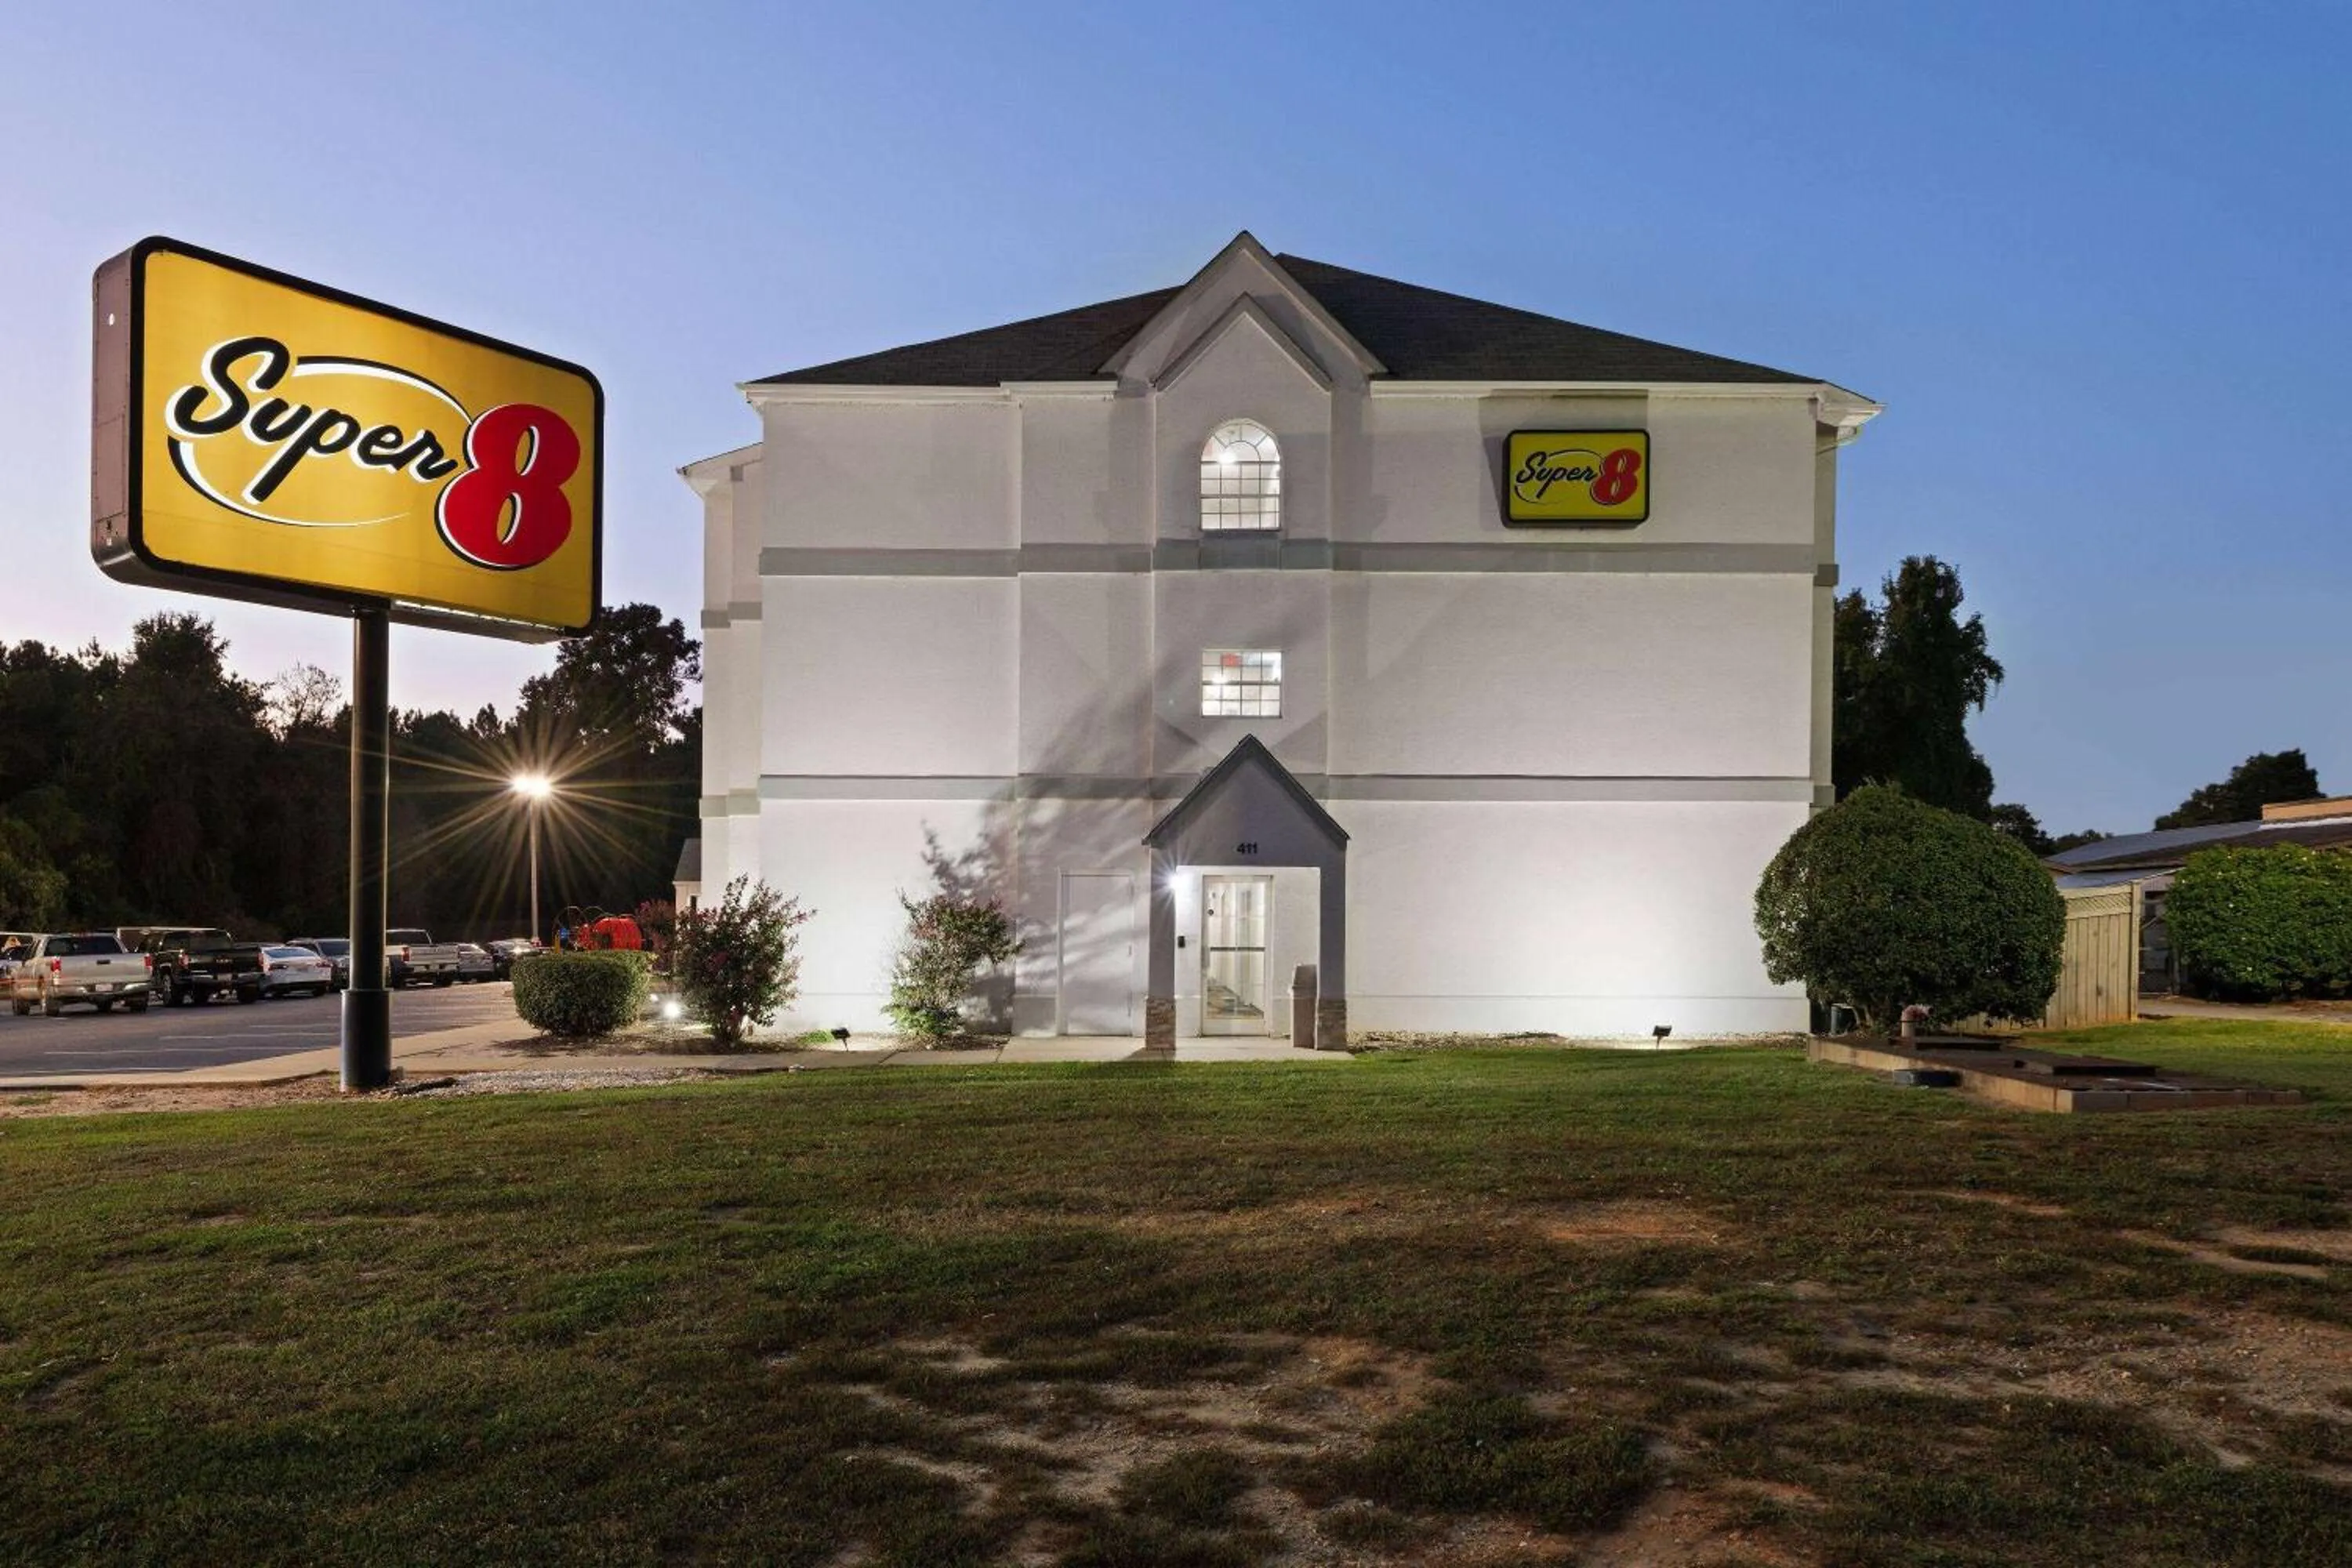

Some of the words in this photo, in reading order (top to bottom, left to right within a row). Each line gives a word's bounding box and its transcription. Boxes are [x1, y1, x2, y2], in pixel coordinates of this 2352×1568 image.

[165, 336, 461, 505] Super
[434, 402, 581, 572] 8
[1515, 451, 1599, 499] Super
[1589, 448, 1642, 506] 8
[1236, 842, 1258, 855] 411
